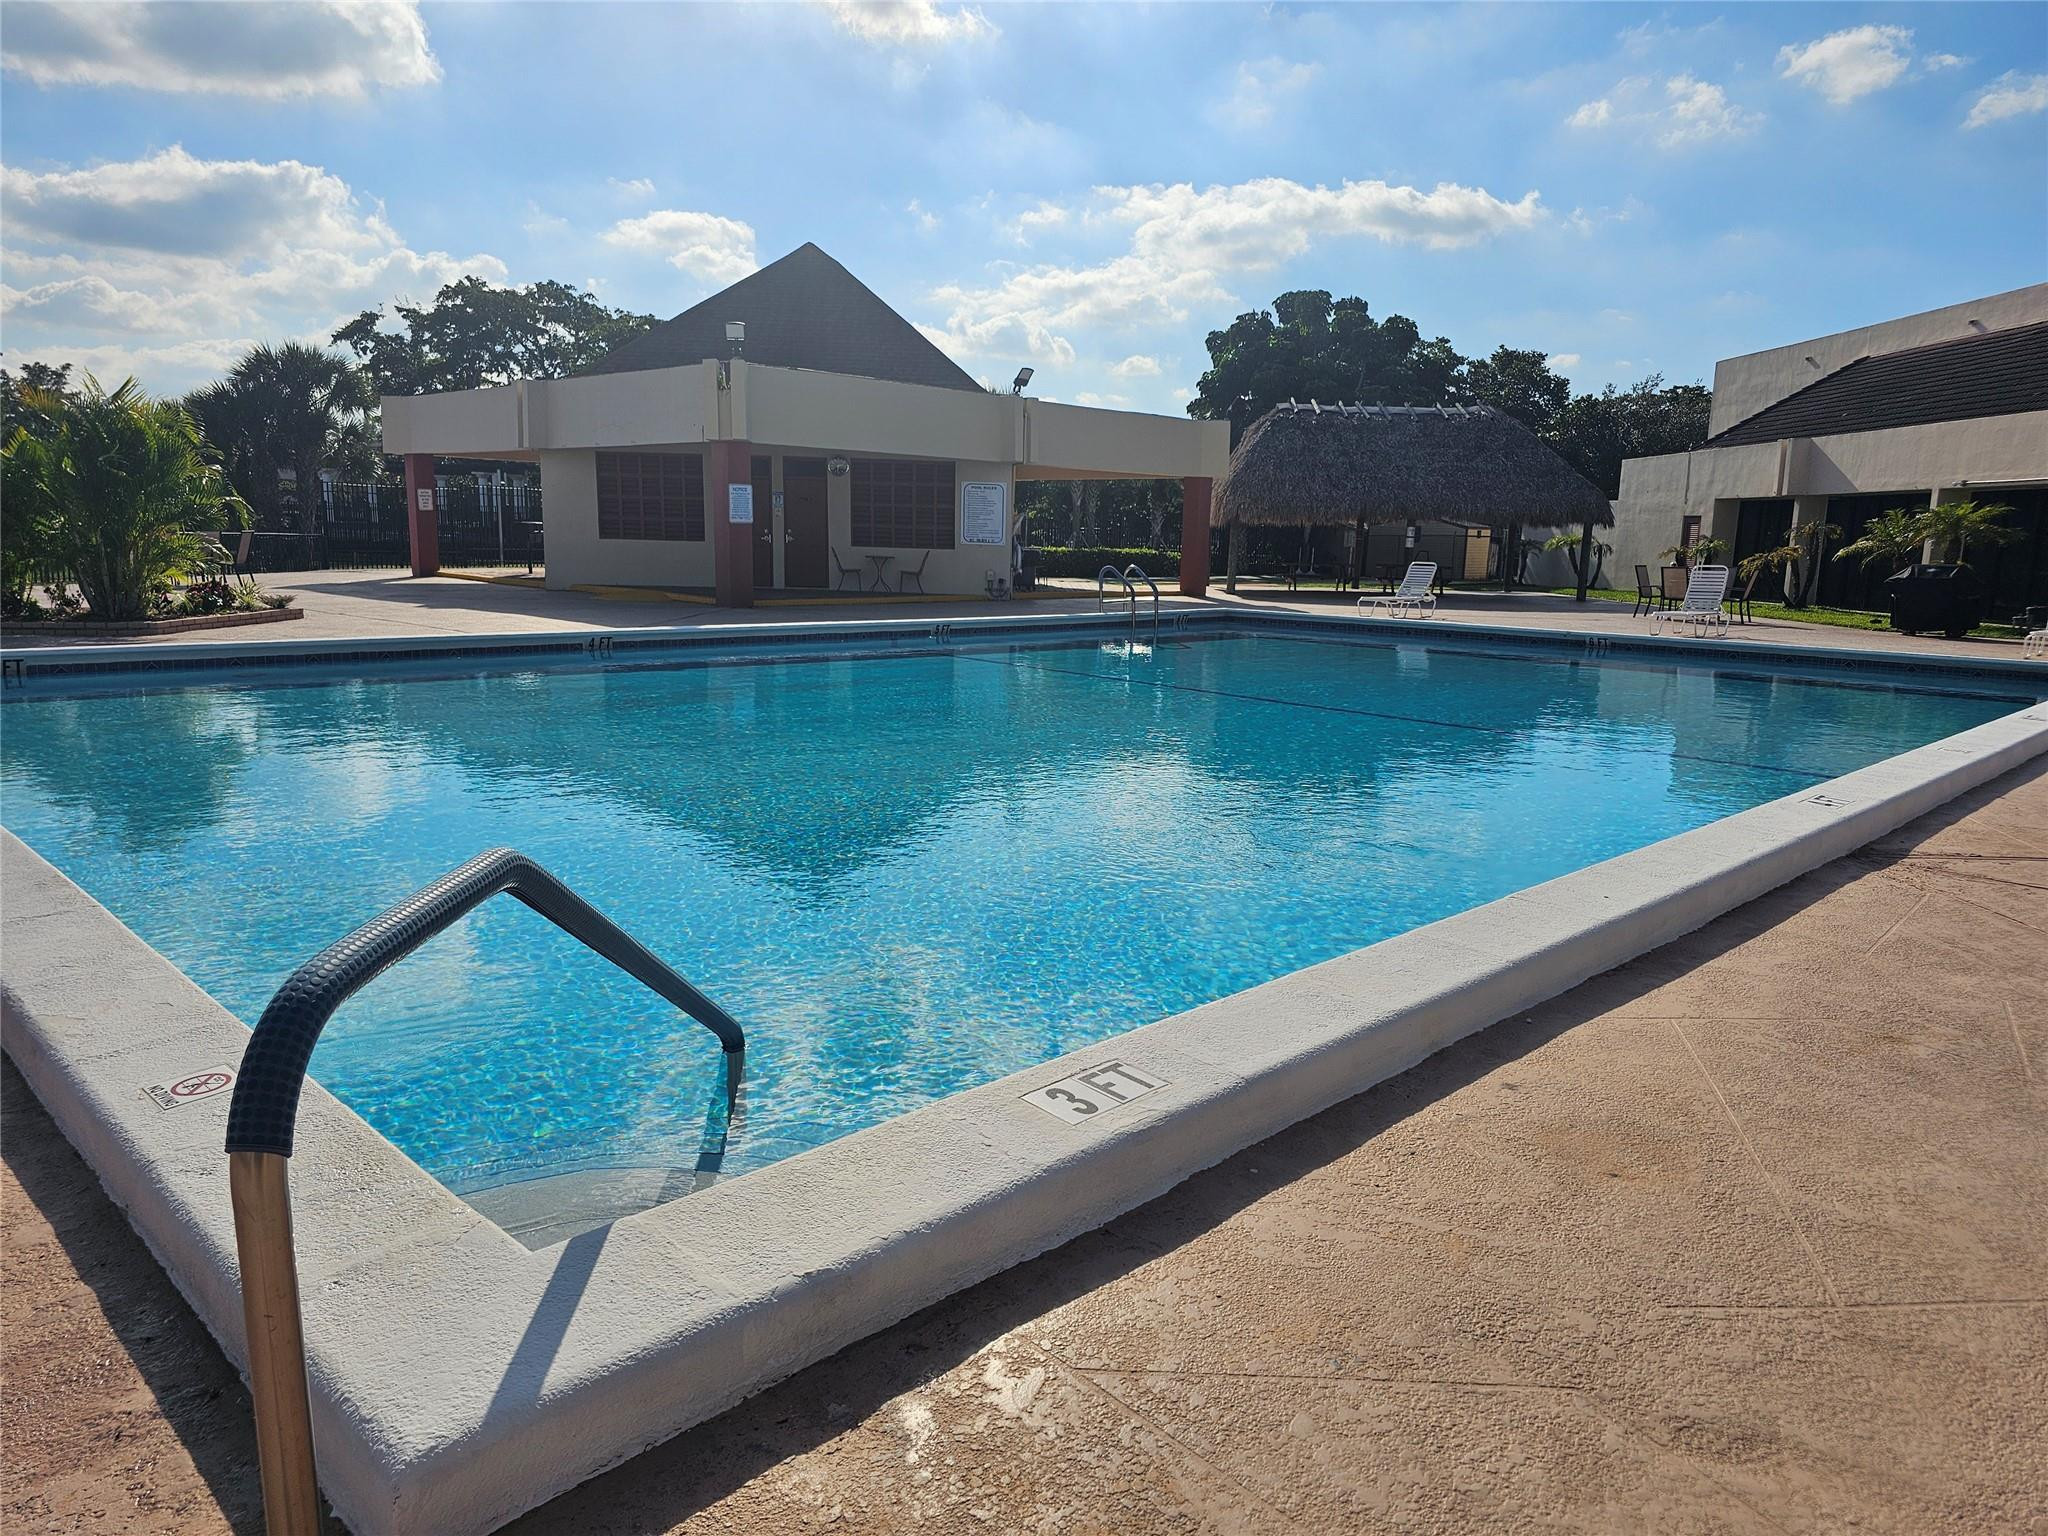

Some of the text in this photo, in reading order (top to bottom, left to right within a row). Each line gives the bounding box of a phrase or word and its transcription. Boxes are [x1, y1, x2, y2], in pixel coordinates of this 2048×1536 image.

[941, 624, 950, 634] FT
[589, 636, 613, 649] 4 FT
[1597, 638, 1609, 647] FT
[3, 659, 24, 676] FT
[147, 1084, 180, 1107] NO DIVING
[1045, 1061, 1155, 1115] 3 FT
